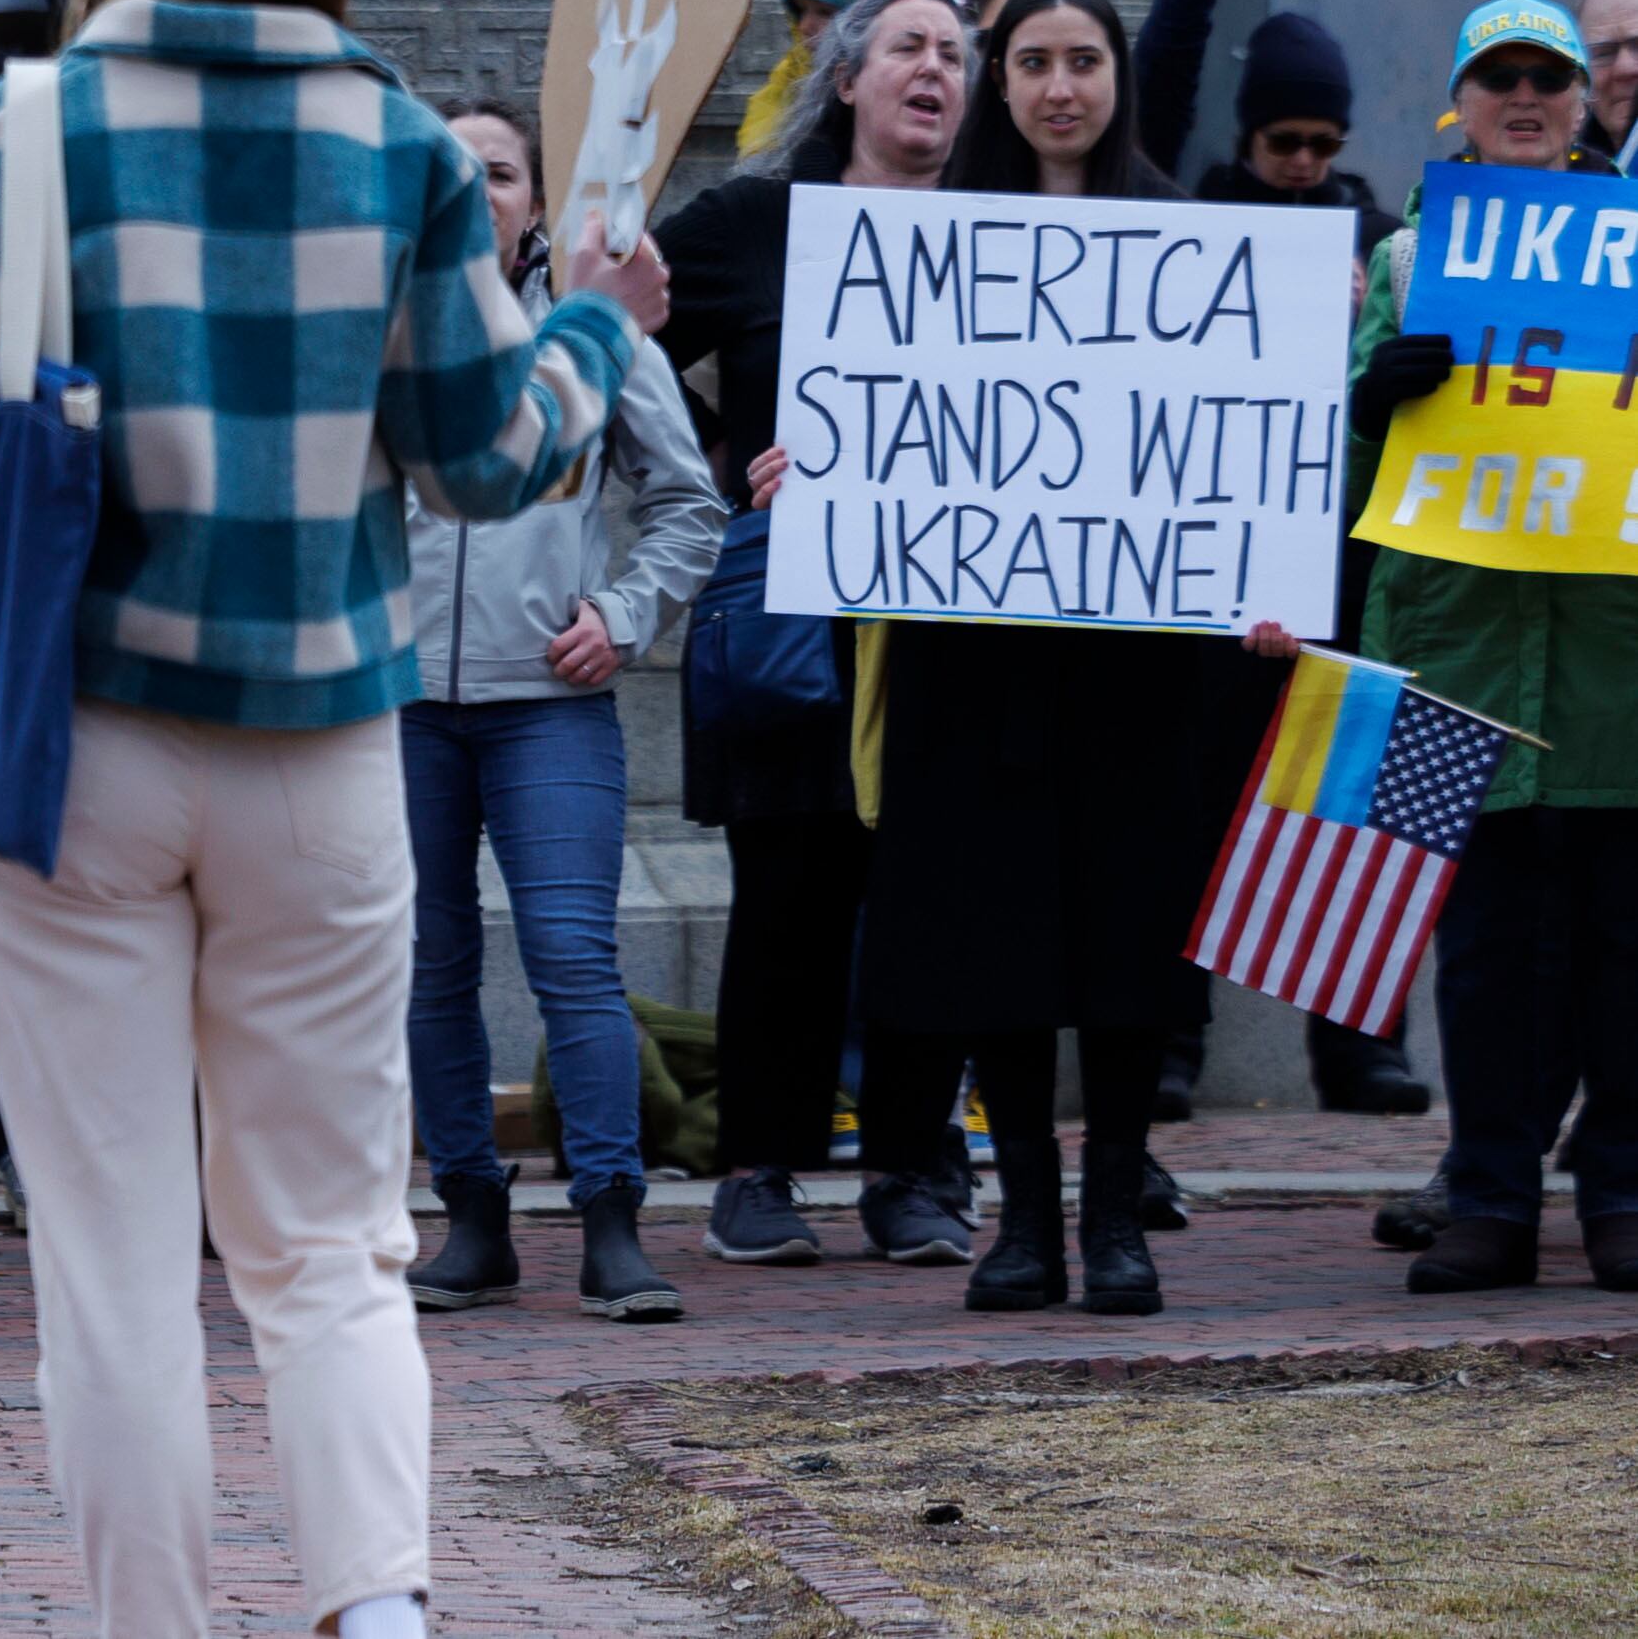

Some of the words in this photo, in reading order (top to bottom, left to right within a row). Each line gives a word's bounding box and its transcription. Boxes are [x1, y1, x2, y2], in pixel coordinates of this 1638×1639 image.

[1466, 10, 1572, 49] UKRAINE
[826, 208, 1261, 360] AMERICA
[1442, 195, 1638, 289] UKR
[1471, 326, 1565, 407] IS
[794, 365, 1083, 491] STANDS
[1129, 390, 1338, 514] WITH
[1390, 453, 1585, 536] FOR
[826, 499, 1251, 619] UKRAINE!
